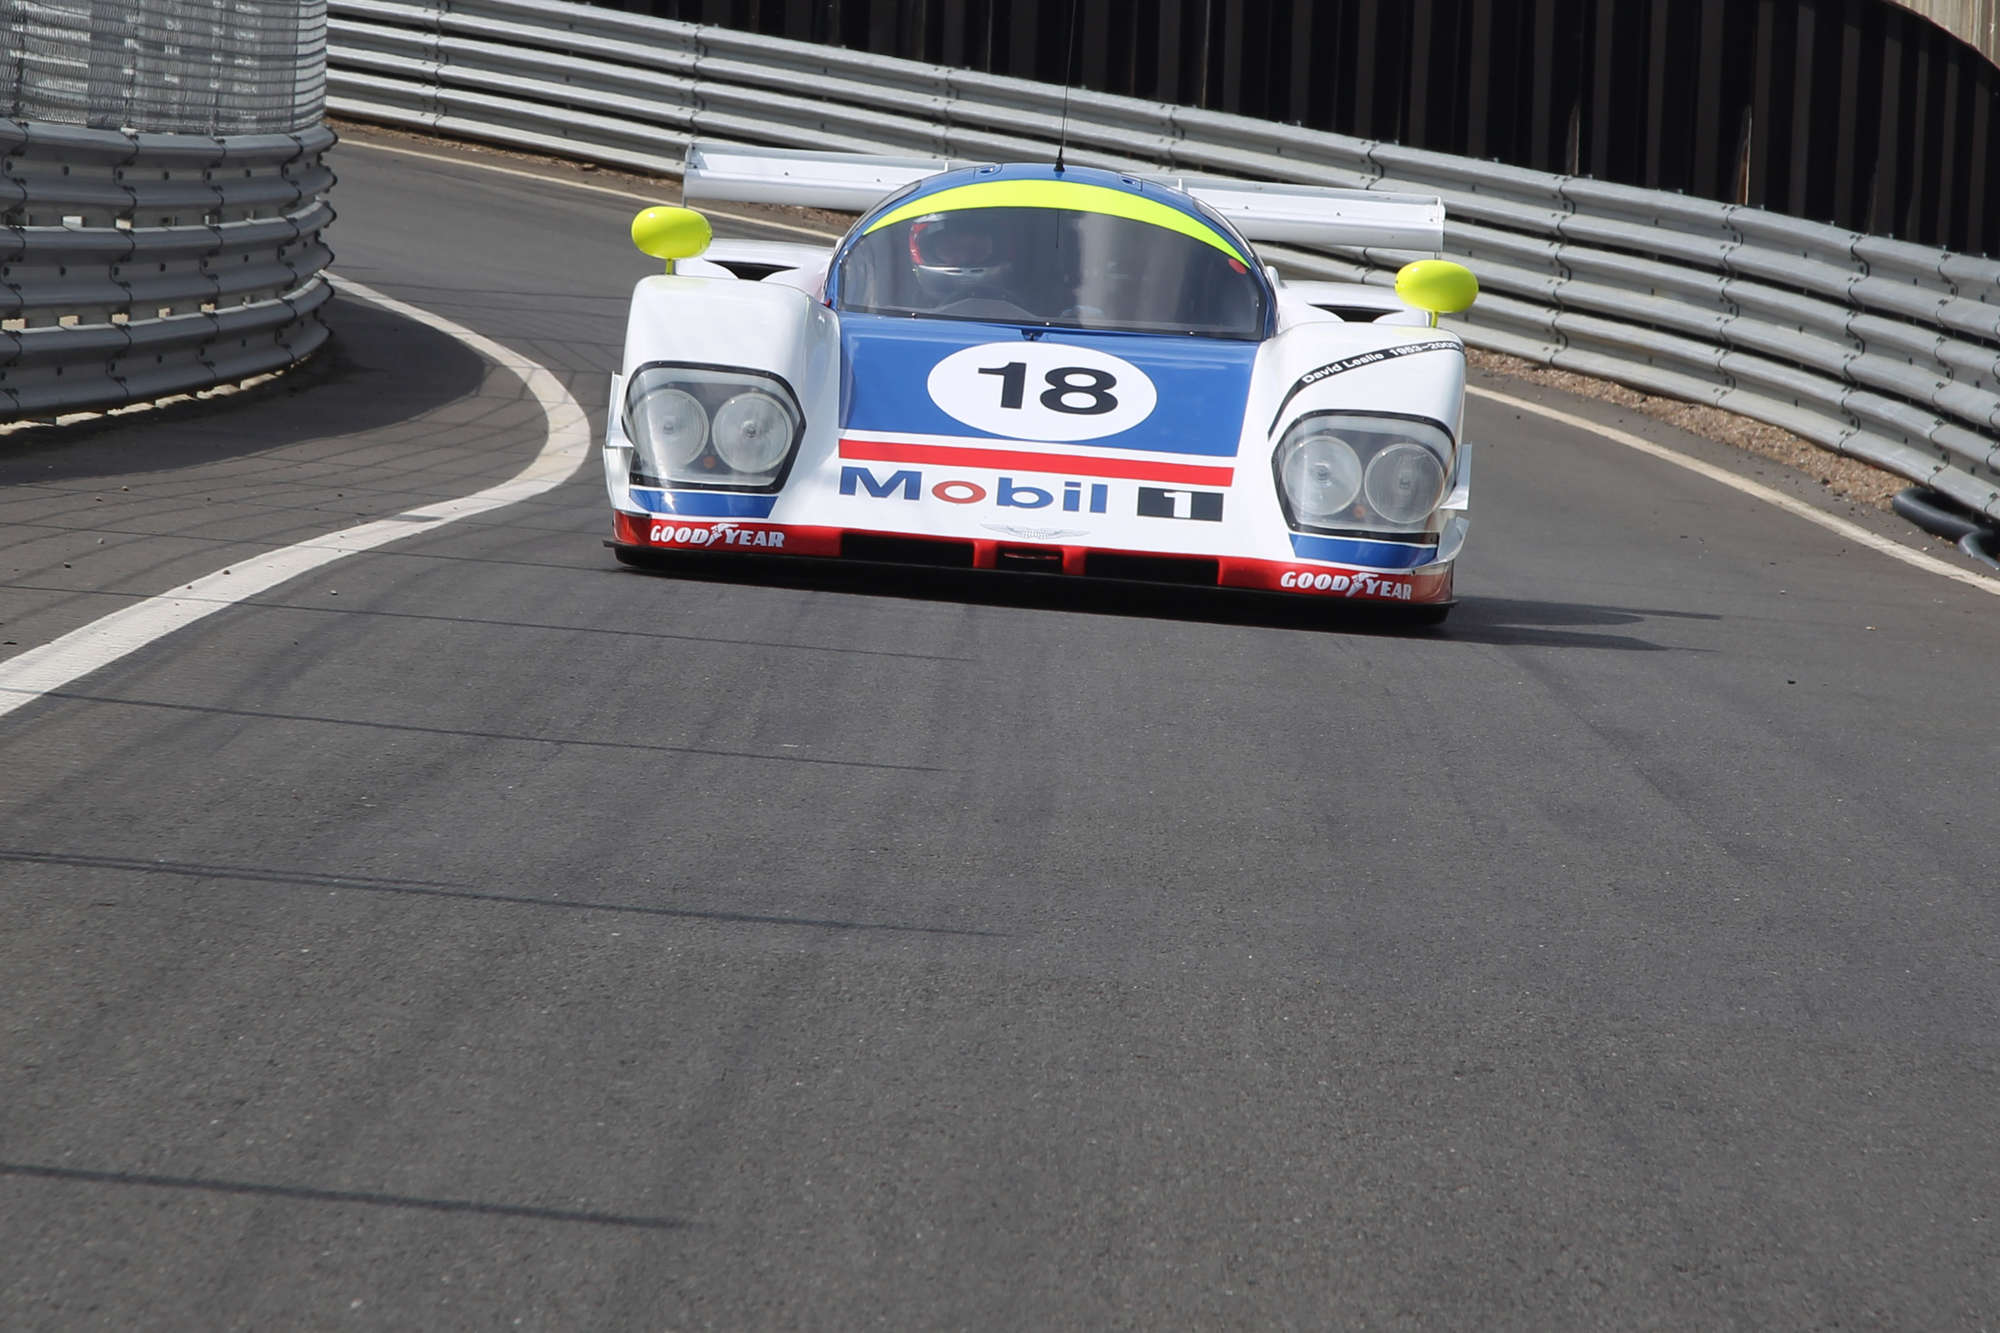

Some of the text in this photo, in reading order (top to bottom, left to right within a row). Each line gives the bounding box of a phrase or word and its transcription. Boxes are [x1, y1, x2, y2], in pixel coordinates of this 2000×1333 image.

[1302, 364, 1341, 384] David
[1344, 353, 1384, 369] Leslie
[978, 362, 1118, 415] 18
[839, 465, 1192, 518] Mobil 1
[650, 523, 785, 548] GOODYEAR
[1280, 571, 1412, 600] GOODYEAR
